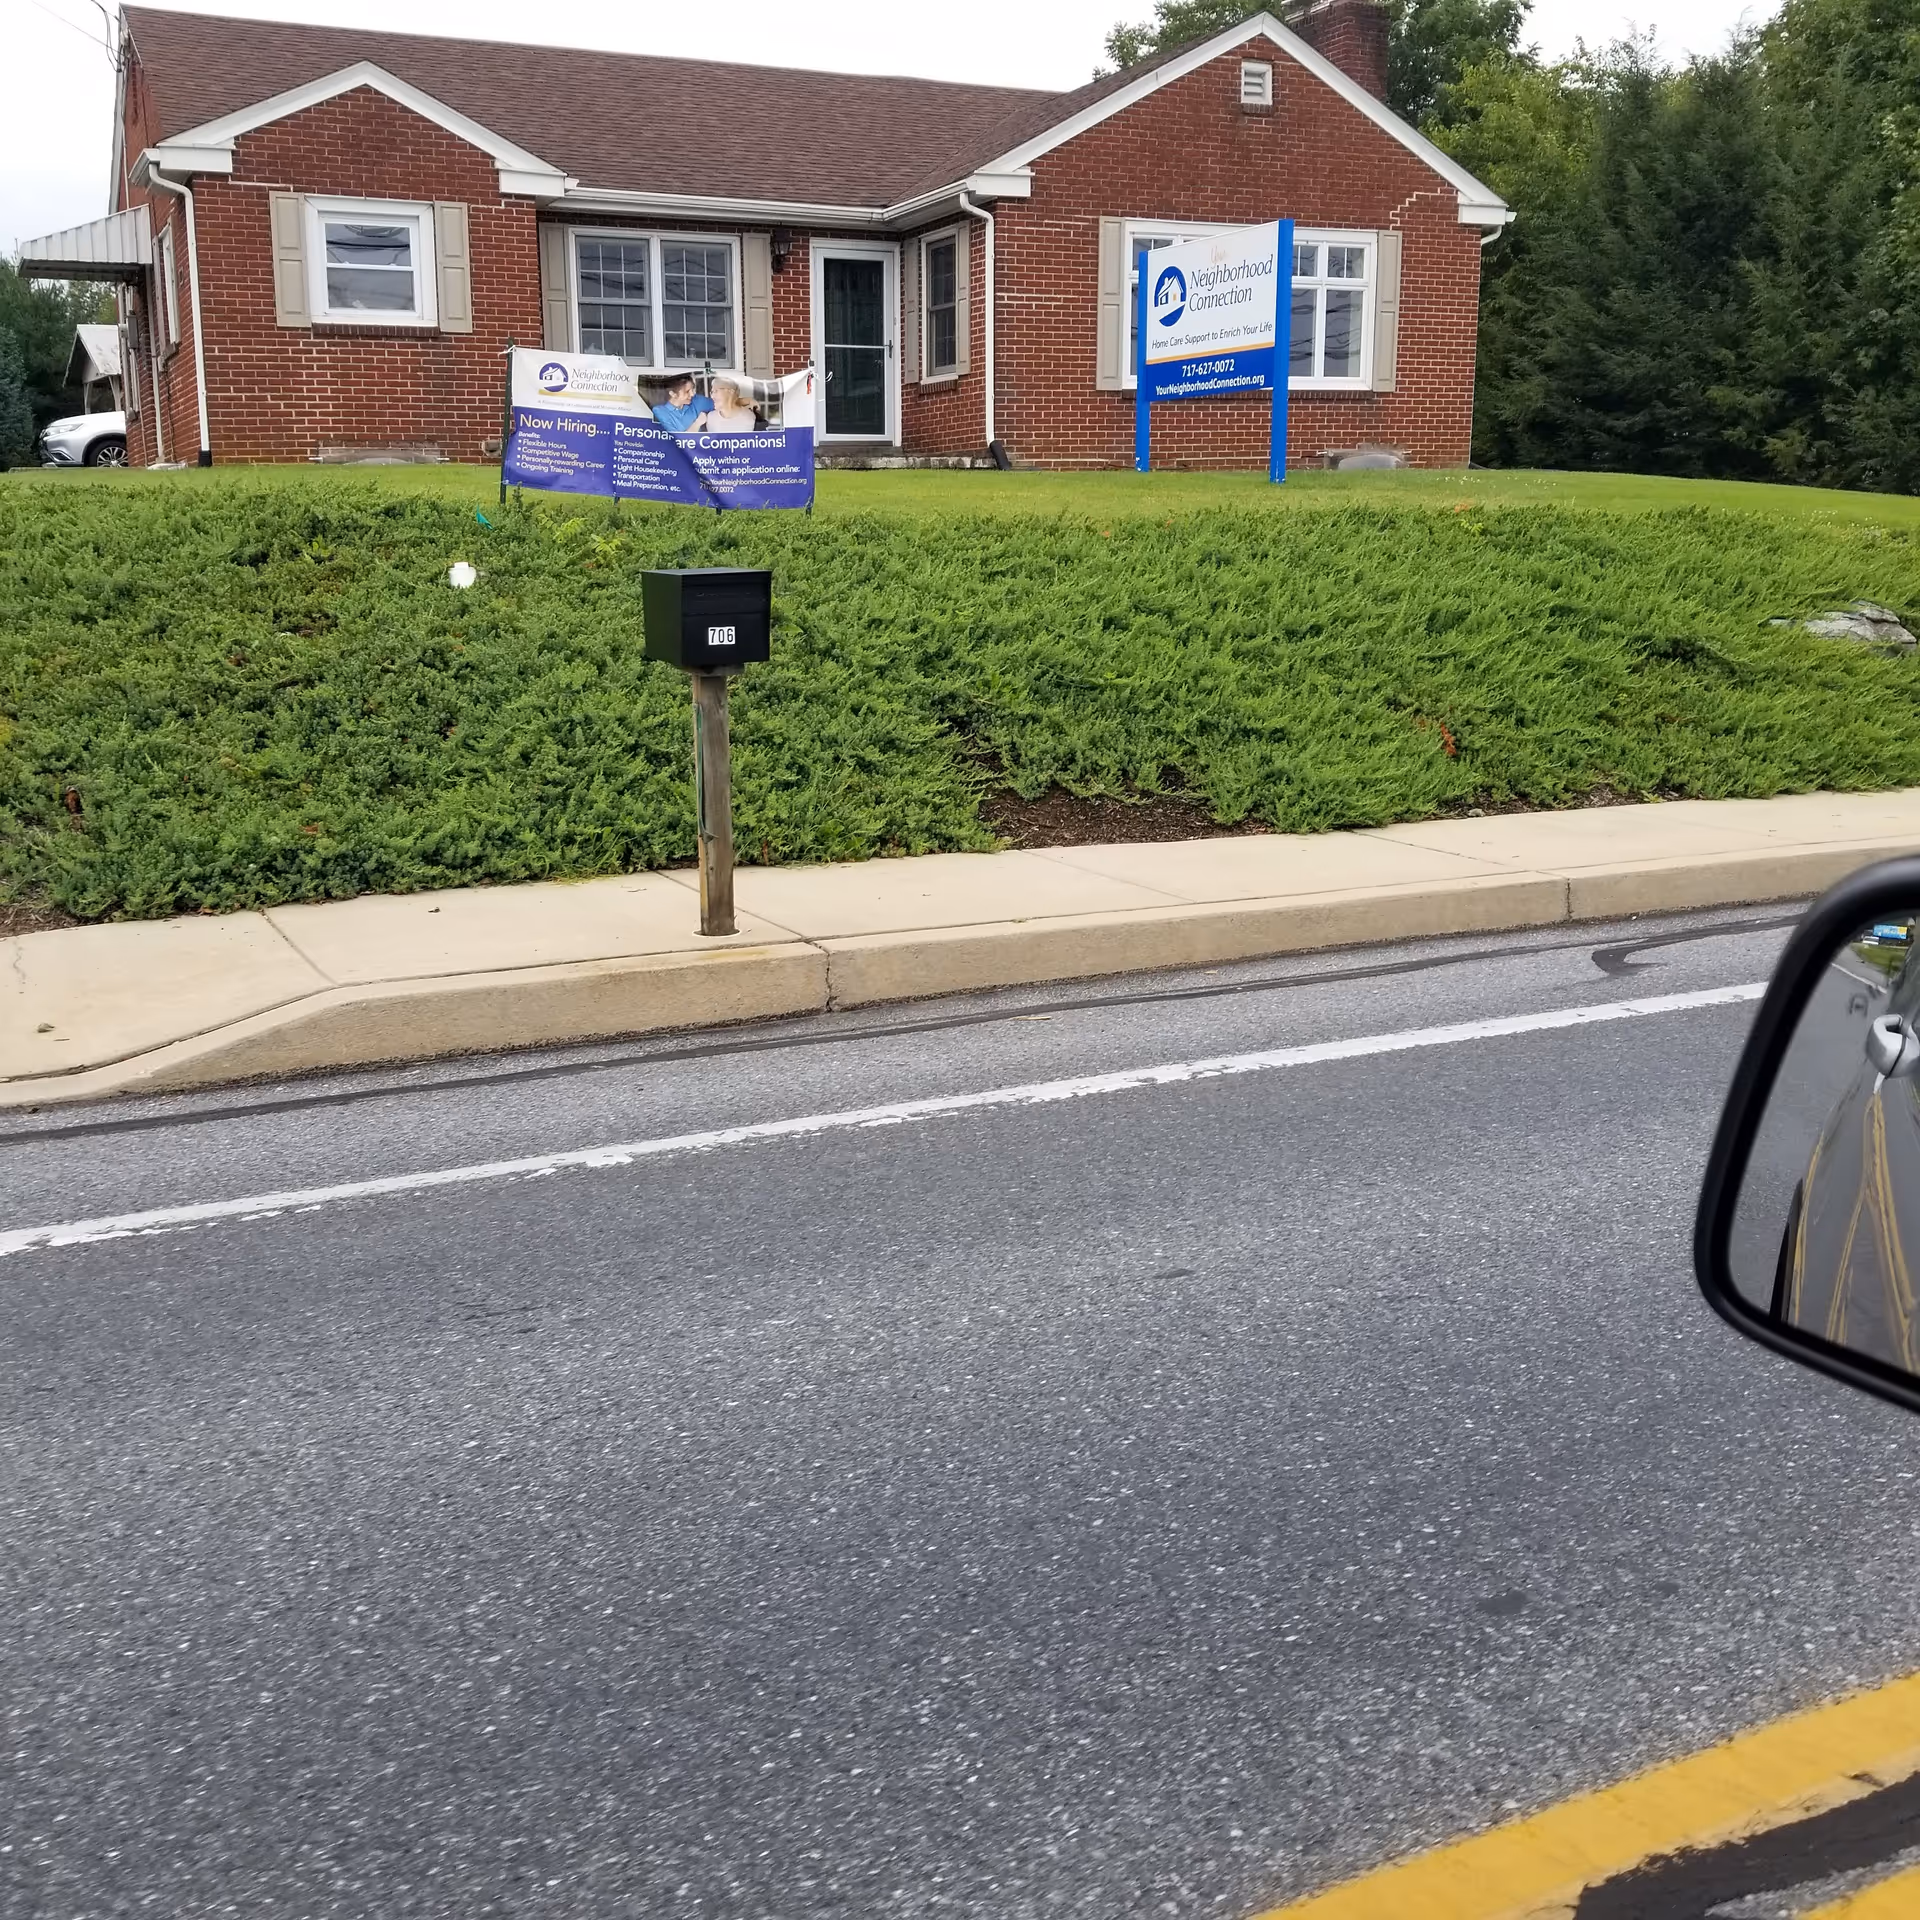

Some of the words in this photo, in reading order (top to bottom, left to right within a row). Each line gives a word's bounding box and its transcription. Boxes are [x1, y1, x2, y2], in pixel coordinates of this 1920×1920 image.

[1190, 254, 1274, 291] Neighborhood
[1189, 286, 1252, 311] Connection
[1151, 339, 1169, 350] Home
[1169, 336, 1183, 347] Care
[1185, 331, 1213, 345] Support
[1211, 331, 1218, 340] to
[1219, 327, 1241, 339] Enrich
[1242, 324, 1258, 335] Your
[1259, 321, 1273, 333] Life
[1181, 359, 1235, 377] 717-627-0072
[570, 380, 618, 392] Connection
[1155, 374, 1265, 395] YourNeighborhoodConnection.org
[518, 431, 541, 439] Benefits:
[520, 413, 553, 430] Now
[557, 417, 610, 437] Hiring....
[615, 422, 672, 441] Persona
[675, 437, 696, 450] are
[699, 435, 786, 453] Companions!
[522, 438, 547, 448] Flexible
[548, 441, 567, 449] Hours
[522, 446, 560, 458] Competitive
[561, 451, 579, 460] Wage
[618, 447, 666, 460] Companionship
[521, 454, 584, 468] Personally-rewarding
[585, 460, 606, 469] Career
[617, 455, 644, 465] Personal
[644, 458, 660, 466] Care
[692, 456, 717, 467] Apply
[717, 456, 741, 465] within
[520, 462, 549, 473] Ongoing
[550, 465, 574, 476] Training
[617, 463, 633, 473] Light
[633, 465, 678, 477] Housekeeping
[696, 466, 720, 475] ubmit
[731, 465, 775, 477] application
[776, 464, 801, 473] online:
[617, 471, 661, 482] Transportation
[616, 479, 632, 488] Meal
[632, 480, 669, 492] Preparation,
[709, 628, 734, 644] 706
